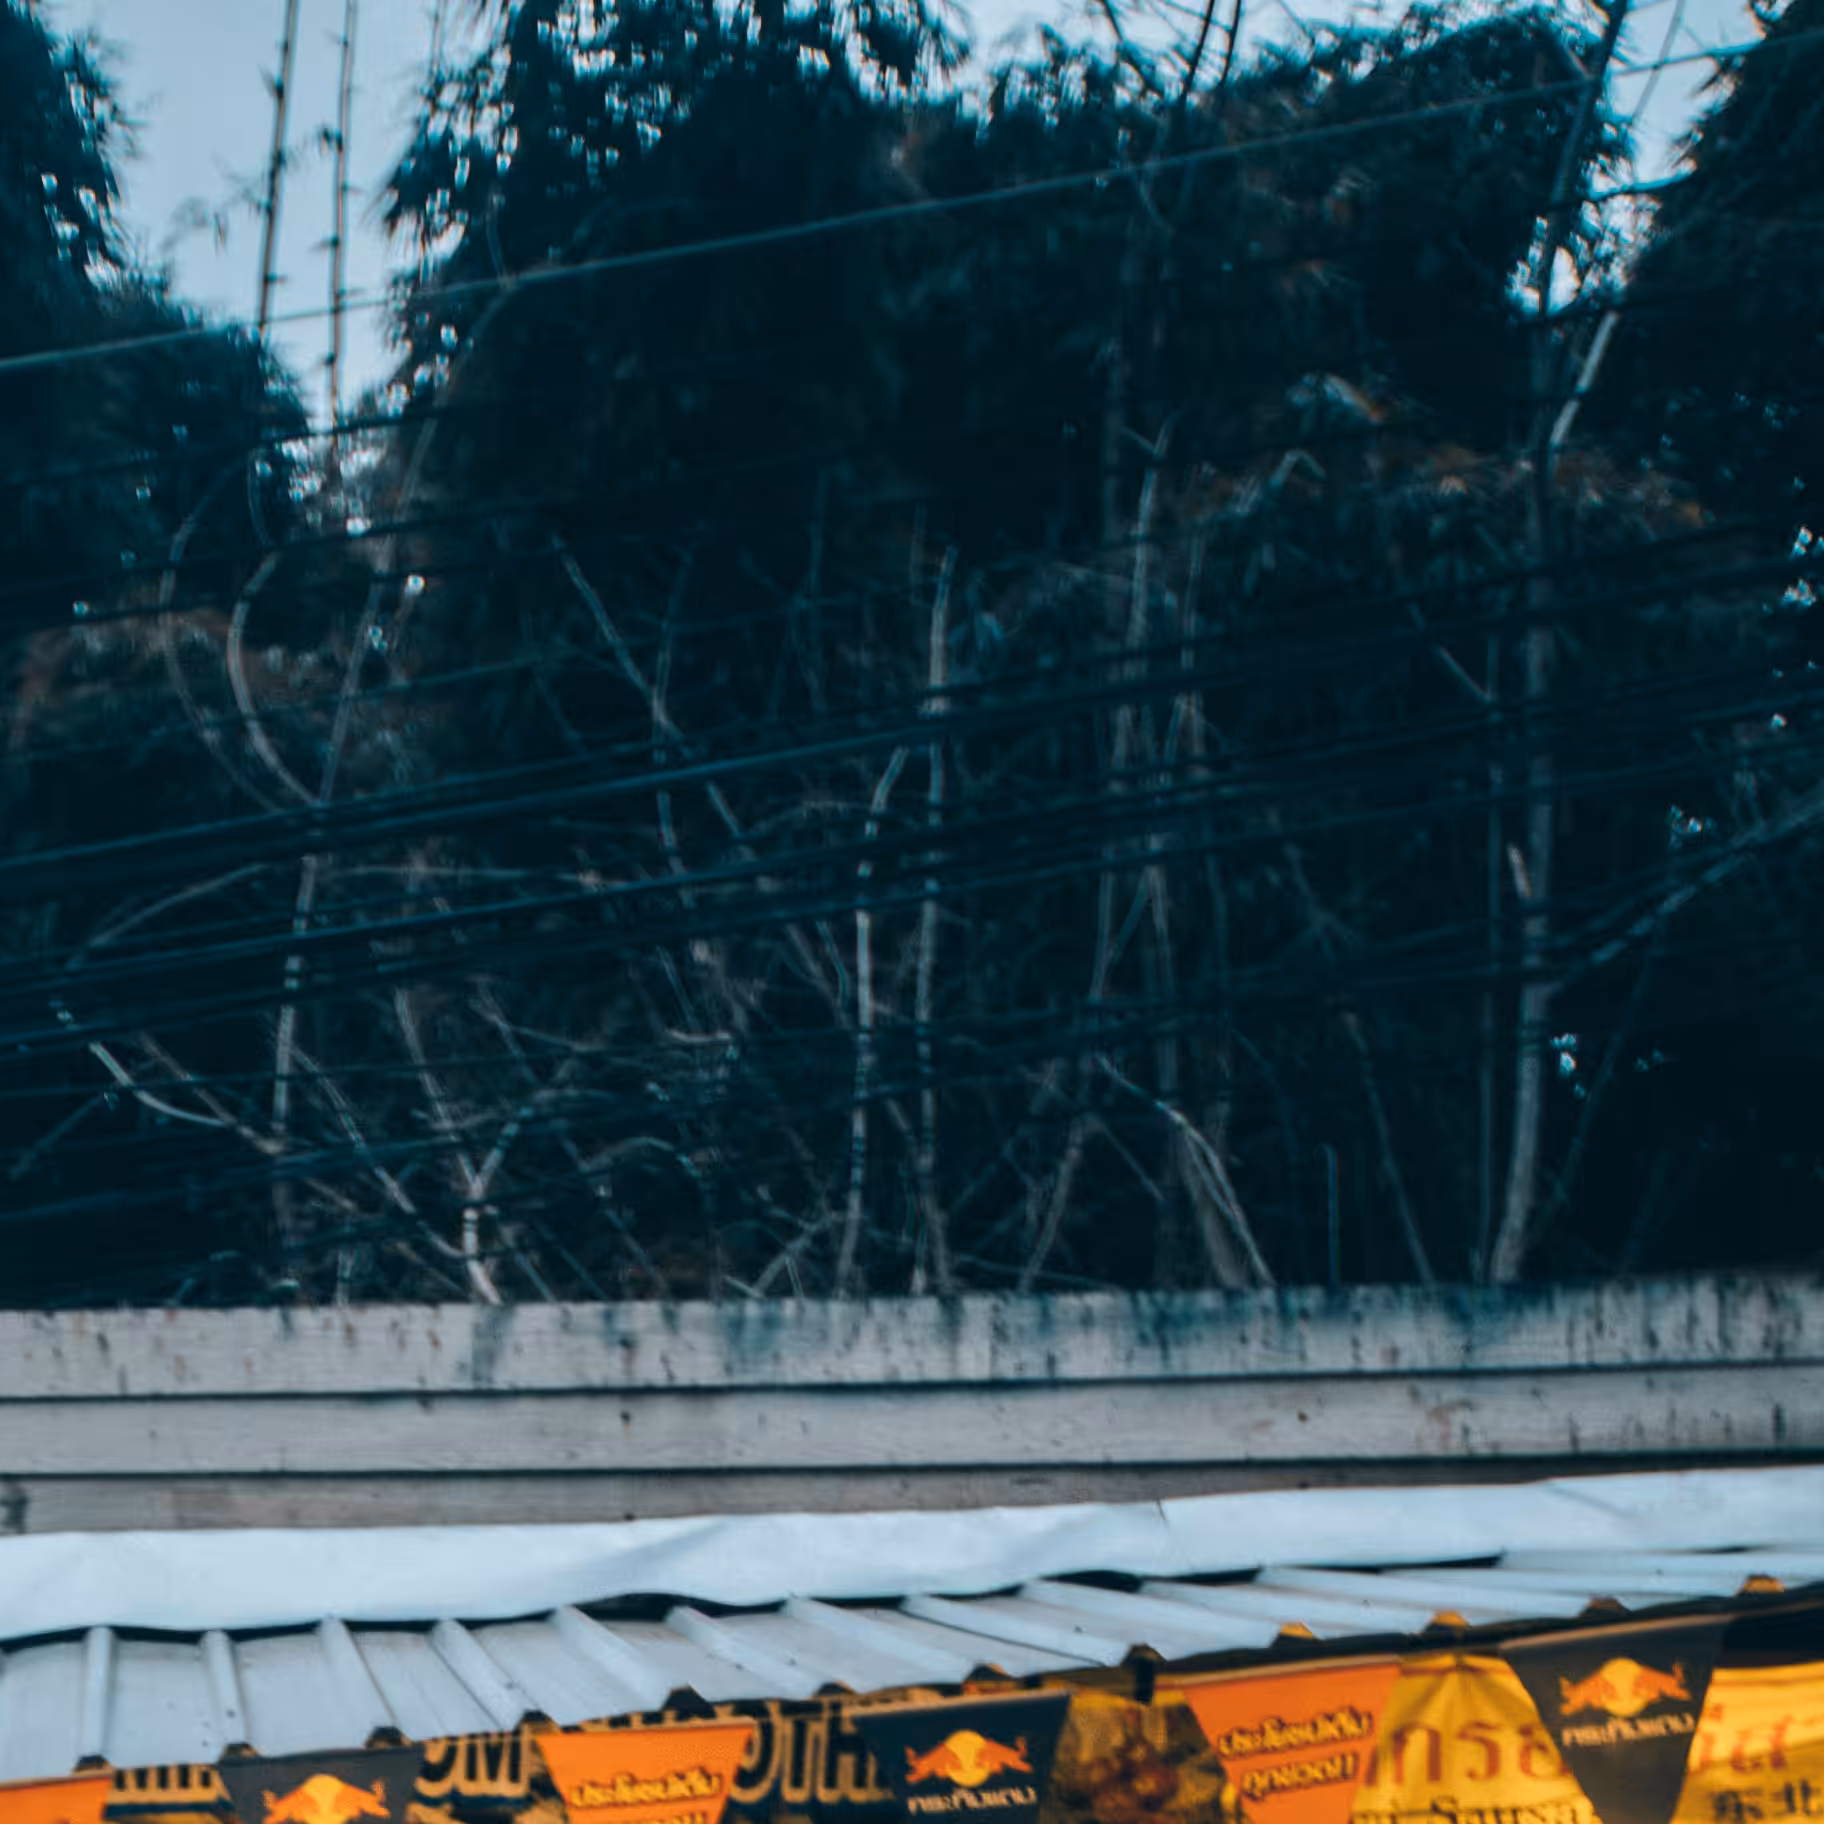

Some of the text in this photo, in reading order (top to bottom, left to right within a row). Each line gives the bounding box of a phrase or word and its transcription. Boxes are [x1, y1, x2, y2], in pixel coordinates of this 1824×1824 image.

[1561, 1713, 1695, 1748] กระทิงแดง
[907, 1786, 1037, 1816] กระทิงแดง
